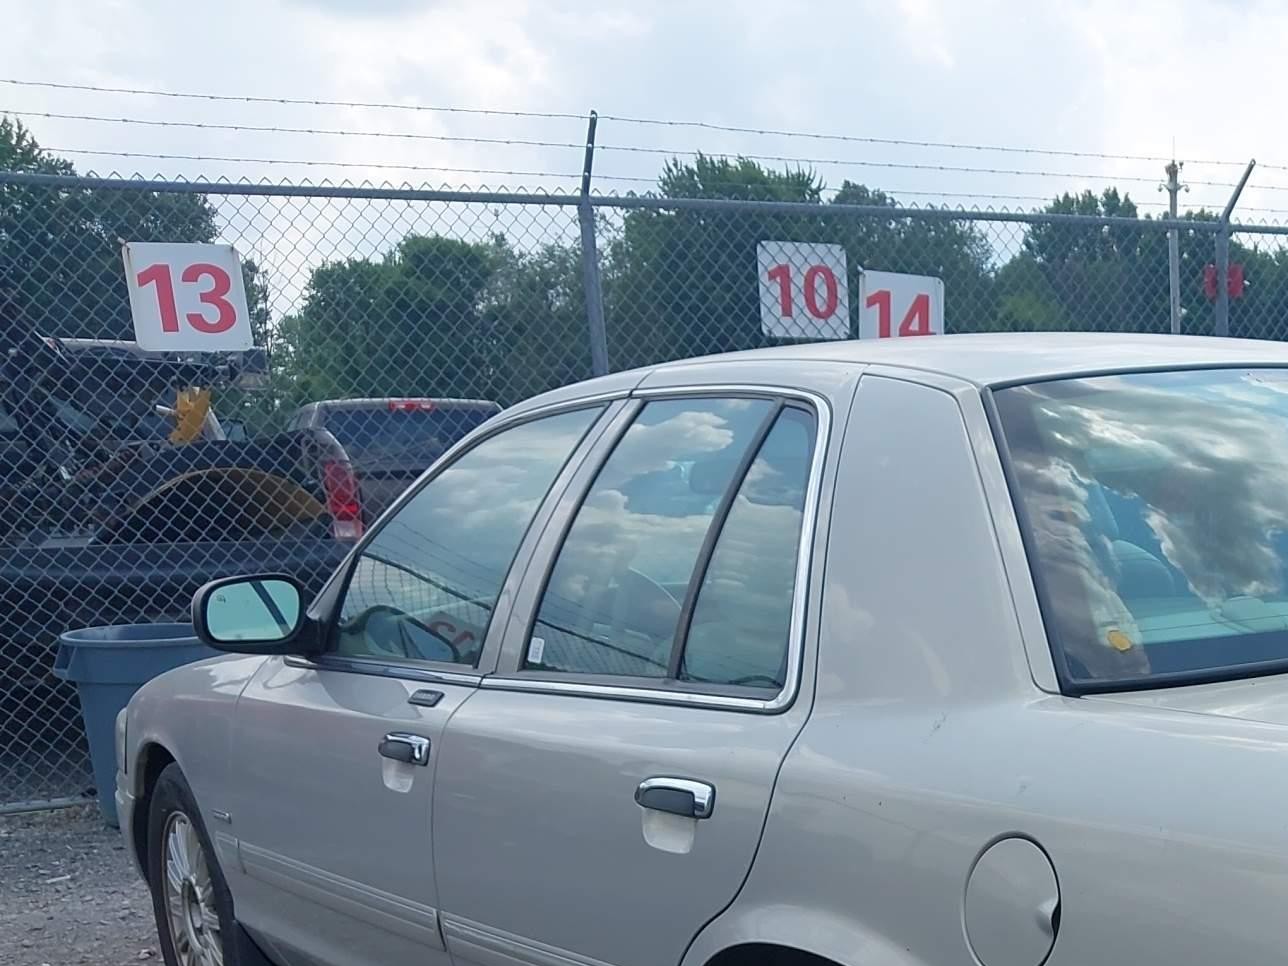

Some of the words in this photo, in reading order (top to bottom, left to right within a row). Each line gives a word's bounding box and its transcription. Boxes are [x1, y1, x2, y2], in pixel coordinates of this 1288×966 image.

[137, 263, 237, 334] 13
[767, 263, 838, 320] 10
[866, 290, 937, 339] 14
